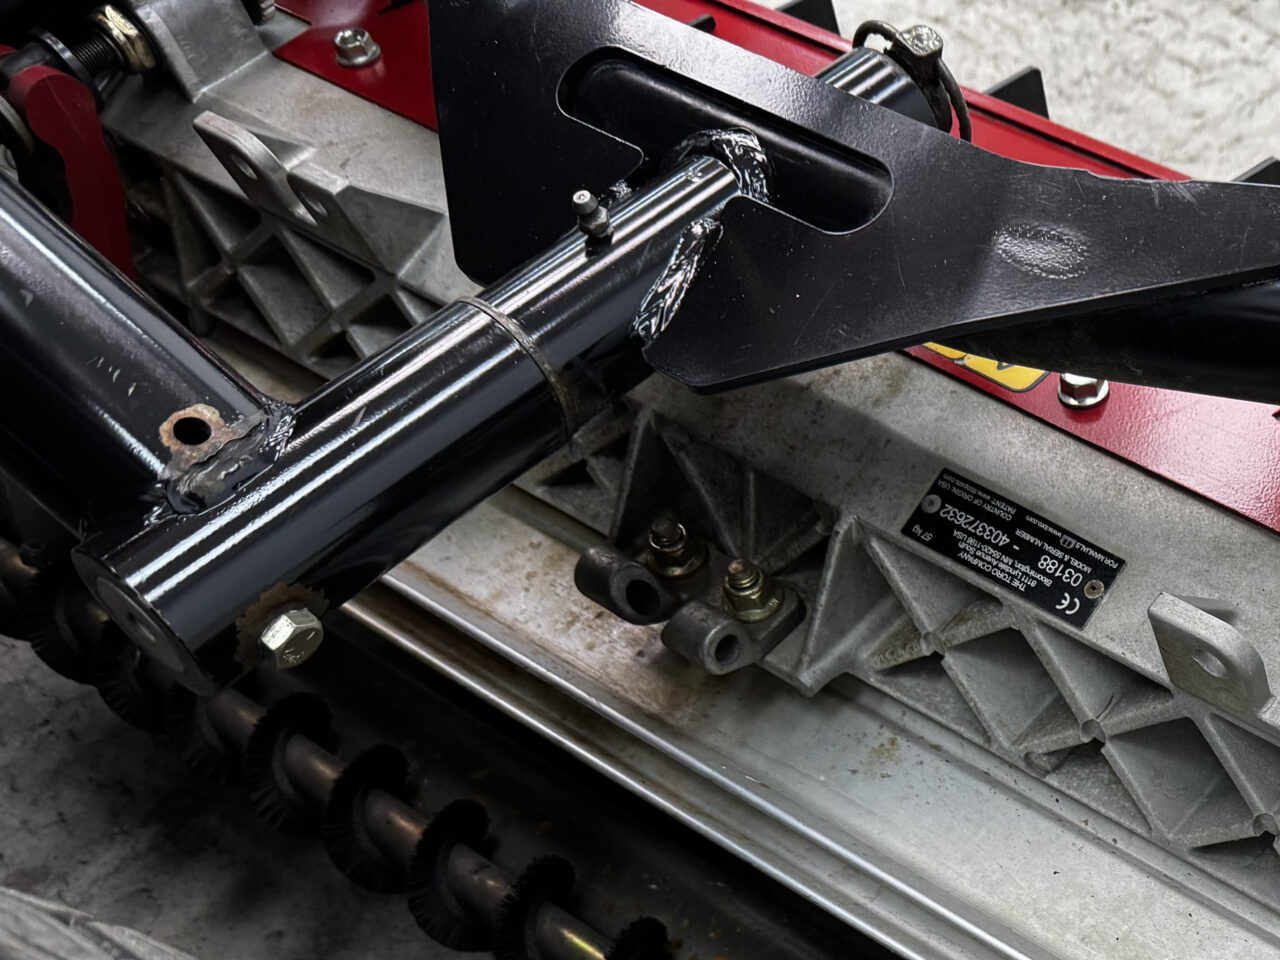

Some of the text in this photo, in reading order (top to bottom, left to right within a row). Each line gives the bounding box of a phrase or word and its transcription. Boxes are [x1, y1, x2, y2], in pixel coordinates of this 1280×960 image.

[937, 479, 951, 491] USA
[972, 498, 983, 506] OF
[990, 499, 1017, 515] PATENT:
[981, 503, 1013, 521] COUNTRY
[911, 524, 934, 542] 57 kg
[939, 503, 1011, 547] 403372632
[953, 529, 968, 542] USA
[1025, 514, 1119, 569] FOR MANUALS www.toro.com
[1000, 554, 1014, 566] MN
[1015, 528, 1093, 574] MODEL & SERIAL NUMBER
[957, 550, 1027, 592] THE TORO COMPANY
[958, 541, 1038, 588] 8111 Lyndale Avenue South
[1037, 554, 1083, 587] 03188
